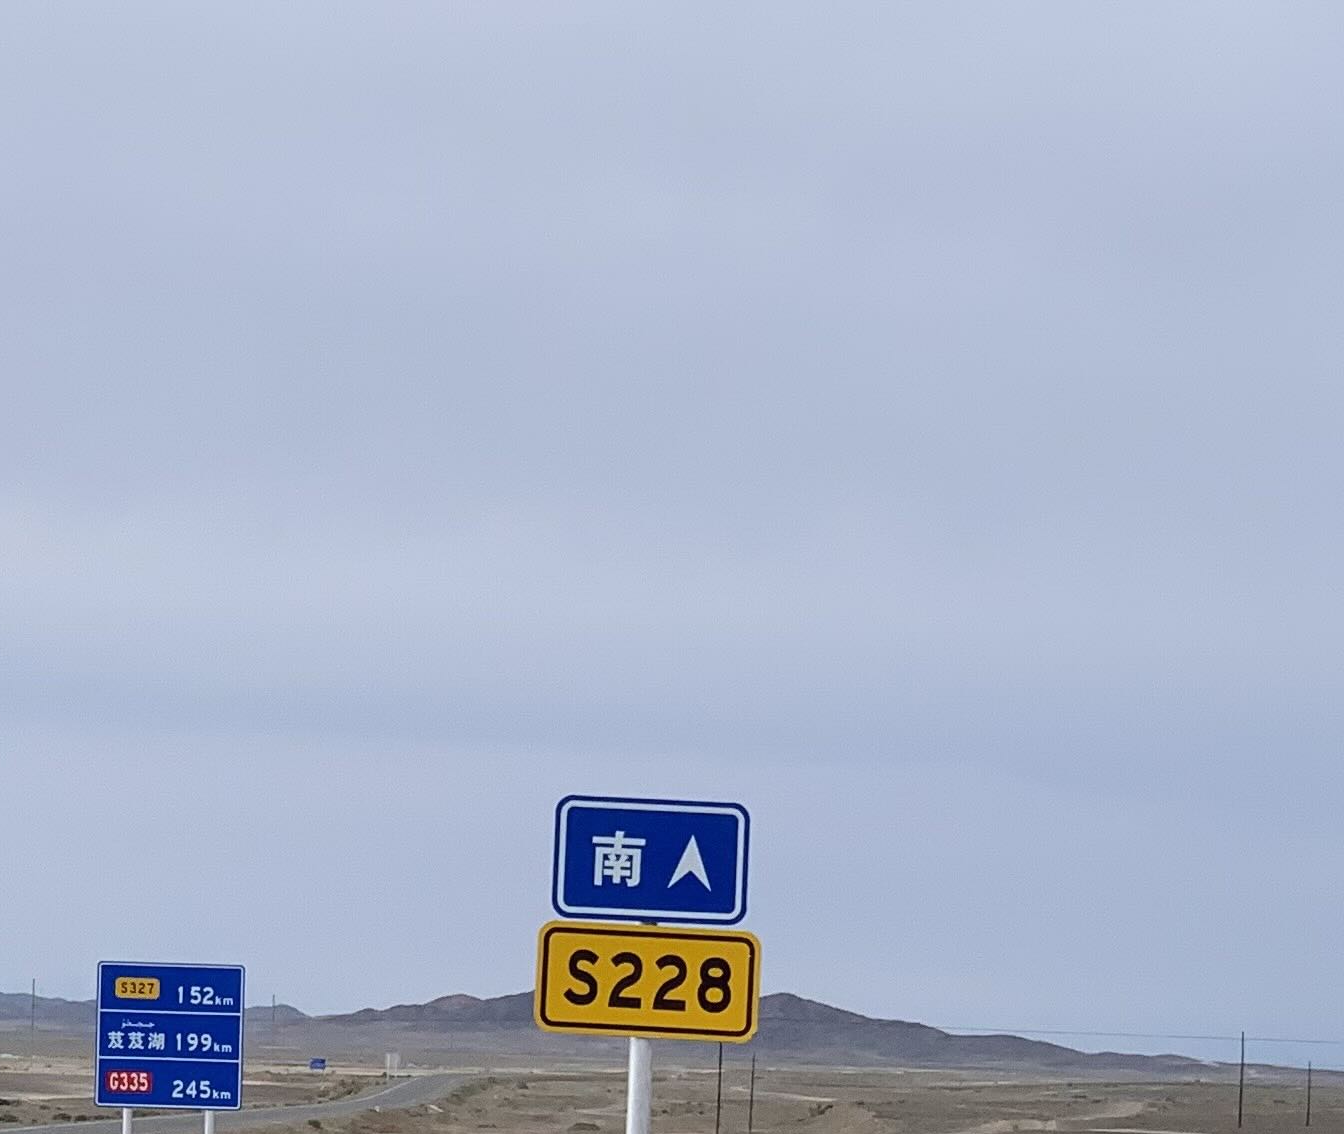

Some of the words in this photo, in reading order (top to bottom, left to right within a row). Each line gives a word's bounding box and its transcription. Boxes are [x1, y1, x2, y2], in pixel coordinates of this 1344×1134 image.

[592, 831, 646, 887] 南
[120, 981, 155, 995] S327
[563, 949, 732, 1013] S228
[107, 1031, 165, 1050] 芨芨湖
[109, 1072, 149, 1092] G335
